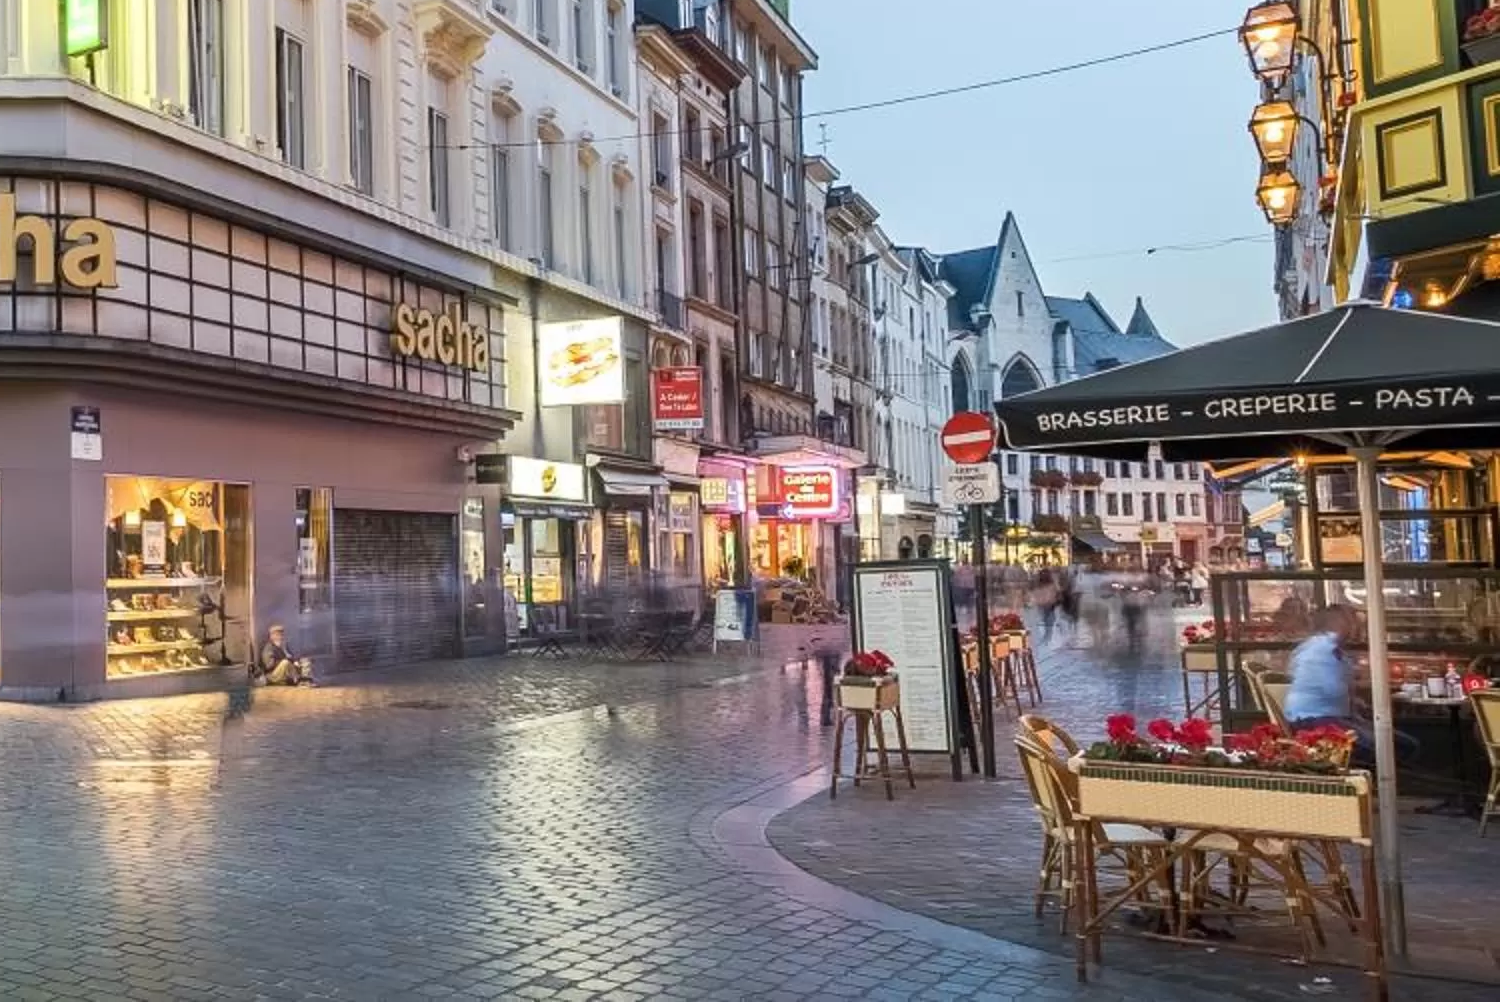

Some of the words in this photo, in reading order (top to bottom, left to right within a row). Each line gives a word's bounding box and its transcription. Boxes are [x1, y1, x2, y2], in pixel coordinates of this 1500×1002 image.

[396, 302, 488, 373] sacha
[1037, 404, 1170, 431] BRASSERIE
[1204, 393, 1337, 418] CREPERIE
[1376, 387, 1474, 410] PASTA
